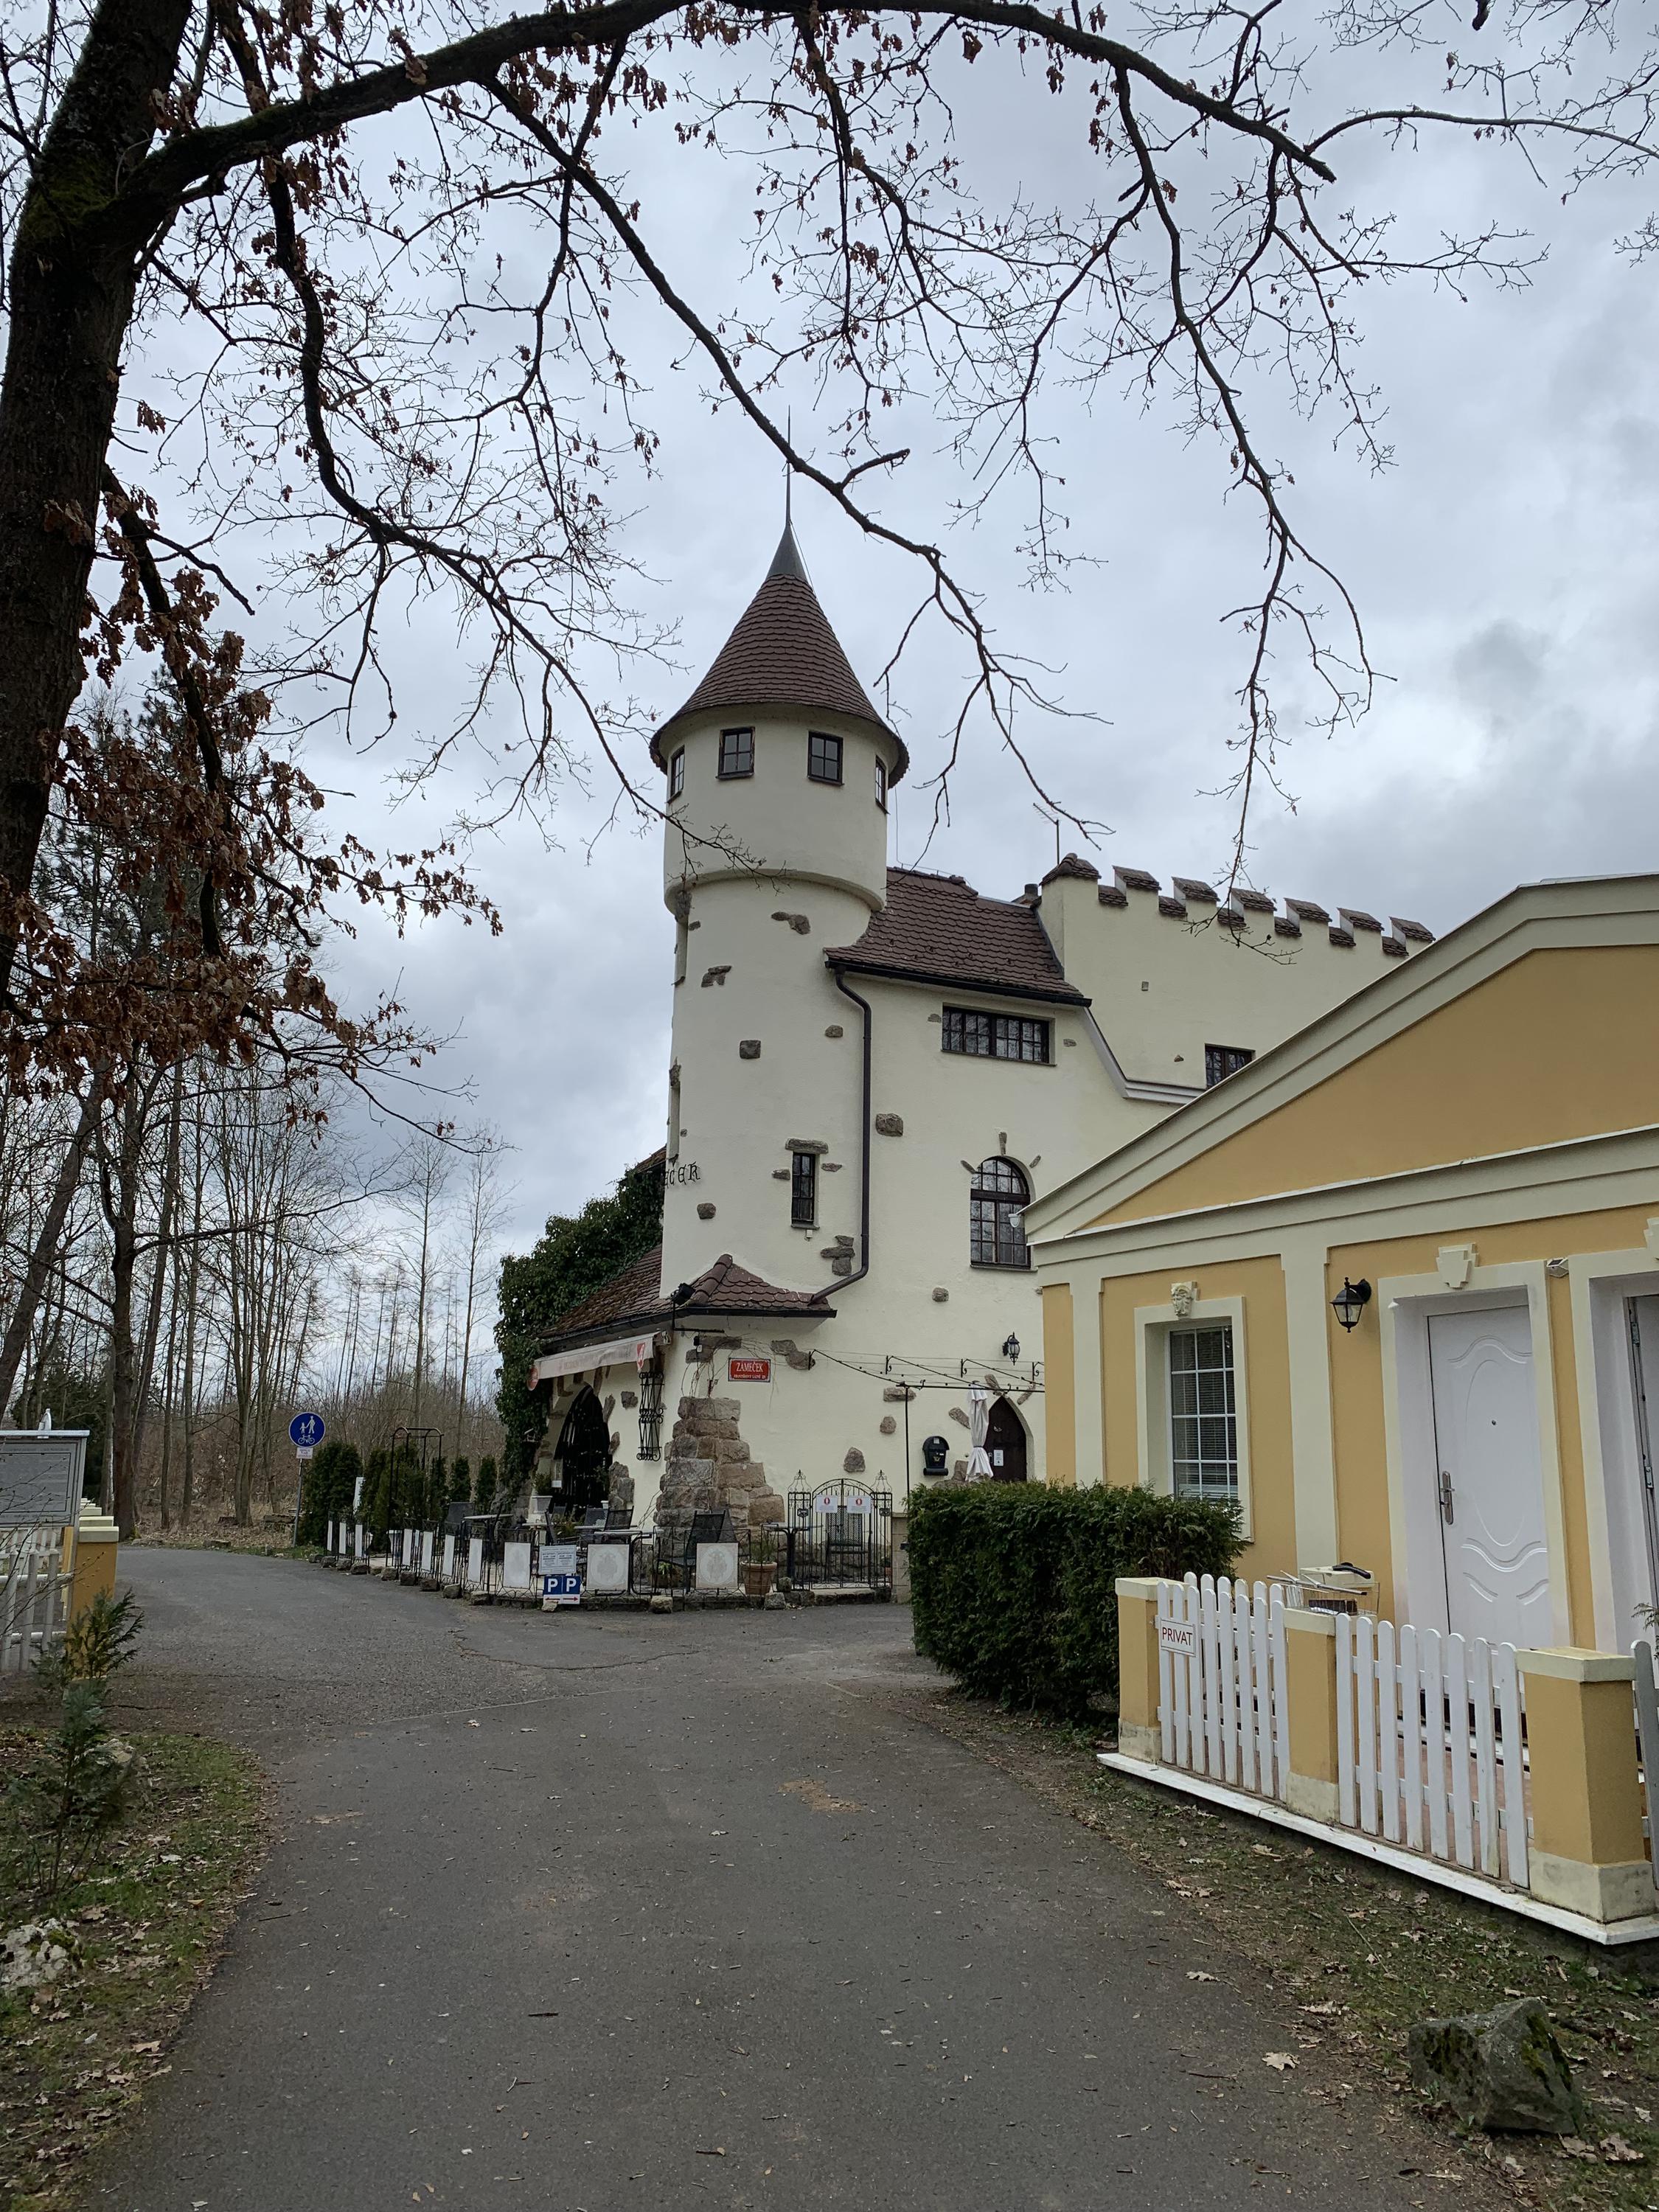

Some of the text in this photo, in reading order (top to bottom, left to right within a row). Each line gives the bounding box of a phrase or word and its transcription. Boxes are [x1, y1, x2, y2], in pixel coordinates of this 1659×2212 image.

[547, 1578, 558, 1593] P
[566, 1577, 577, 1593] P
[1162, 1627, 1193, 1646] PRIVAT
